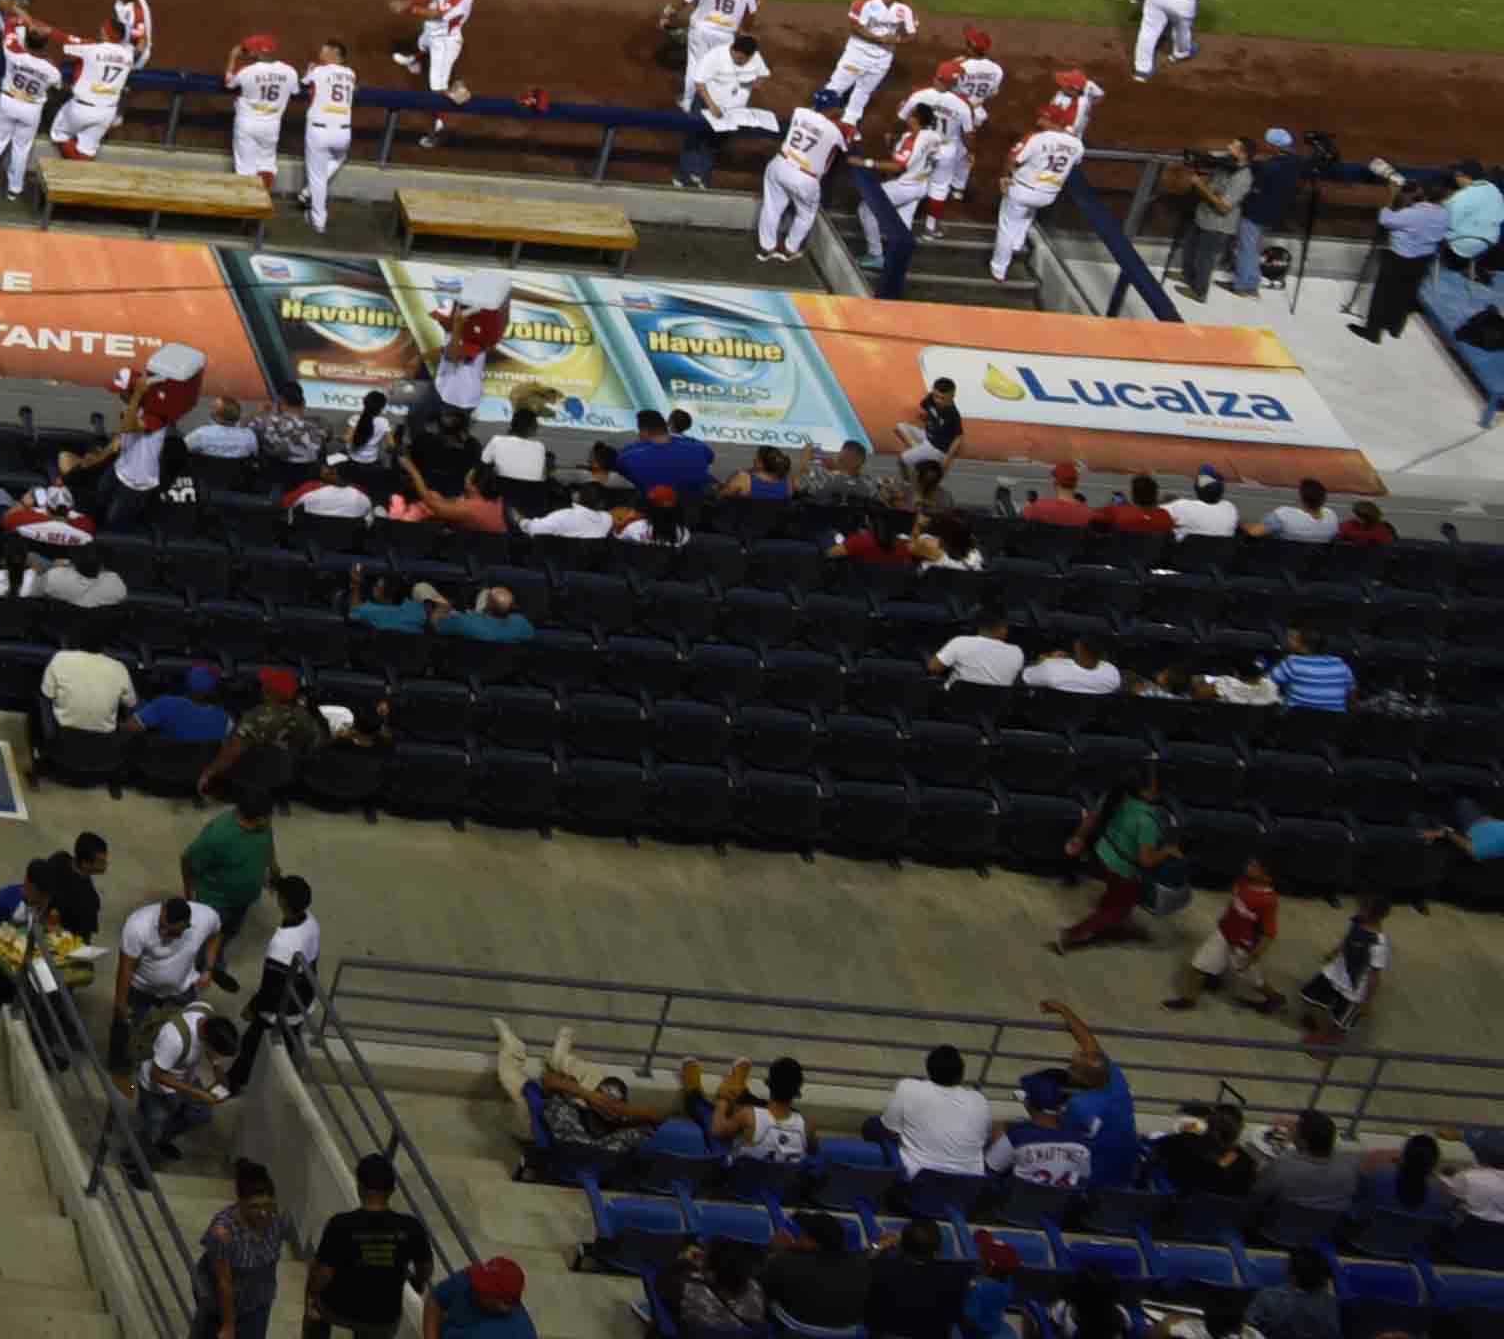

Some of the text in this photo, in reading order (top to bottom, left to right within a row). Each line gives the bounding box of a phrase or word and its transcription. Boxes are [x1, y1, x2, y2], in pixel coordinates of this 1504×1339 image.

[102, 65, 123, 83] 17
[12, 72, 41, 96] 66
[259, 84, 280, 102] 16
[331, 84, 352, 102] 61
[789, 130, 818, 154] 27
[1046, 154, 1069, 173] 12
[648, 331, 785, 363] Havoline
[1016, 363, 1294, 423] Lucalza
[700, 424, 782, 442] MOTOR
